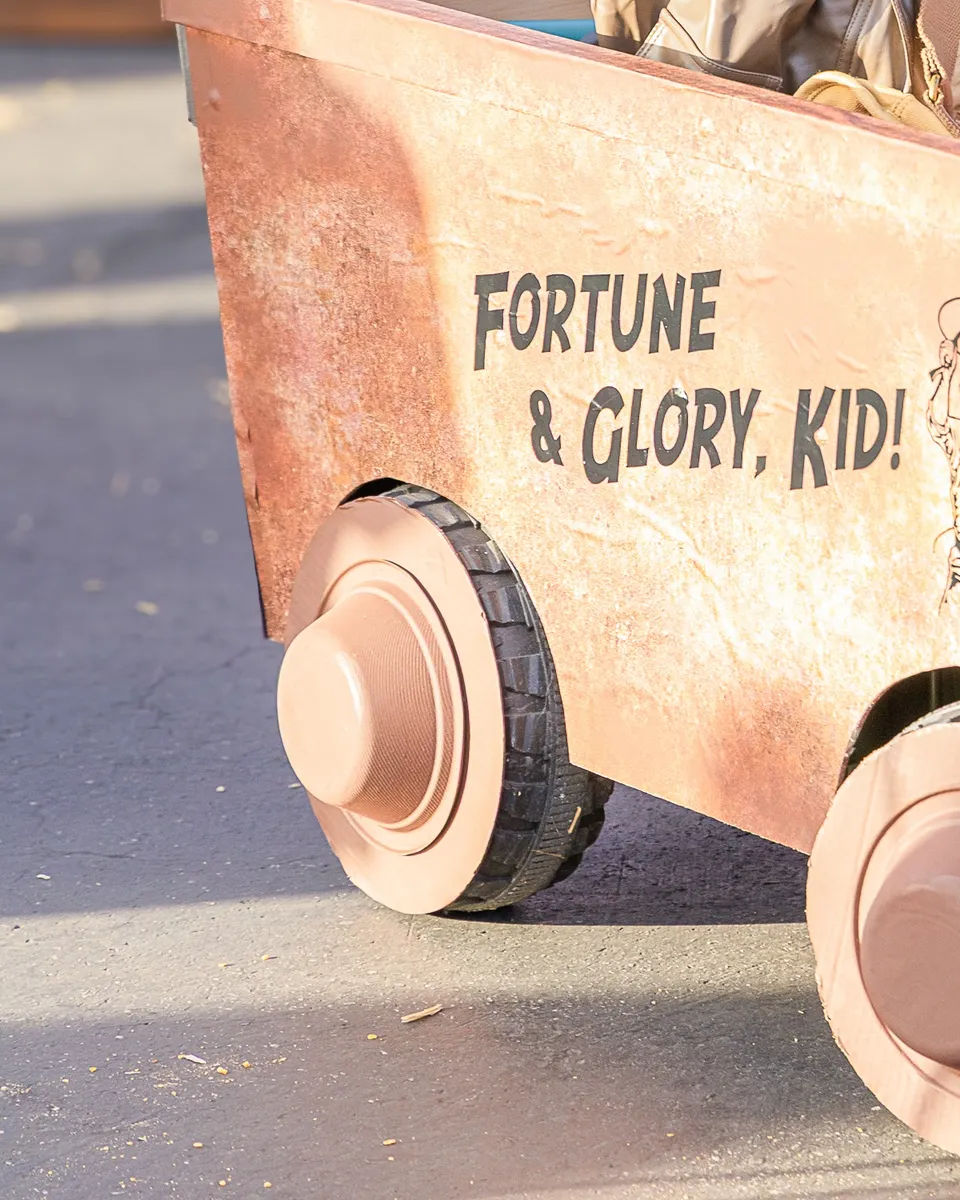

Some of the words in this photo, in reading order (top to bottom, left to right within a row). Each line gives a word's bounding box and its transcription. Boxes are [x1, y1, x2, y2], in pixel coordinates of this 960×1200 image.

[474, 269, 722, 371] FORTUNE
[529, 389, 565, 466] &
[582, 385, 767, 484] GLORY,
[789, 386, 907, 491] KID!
